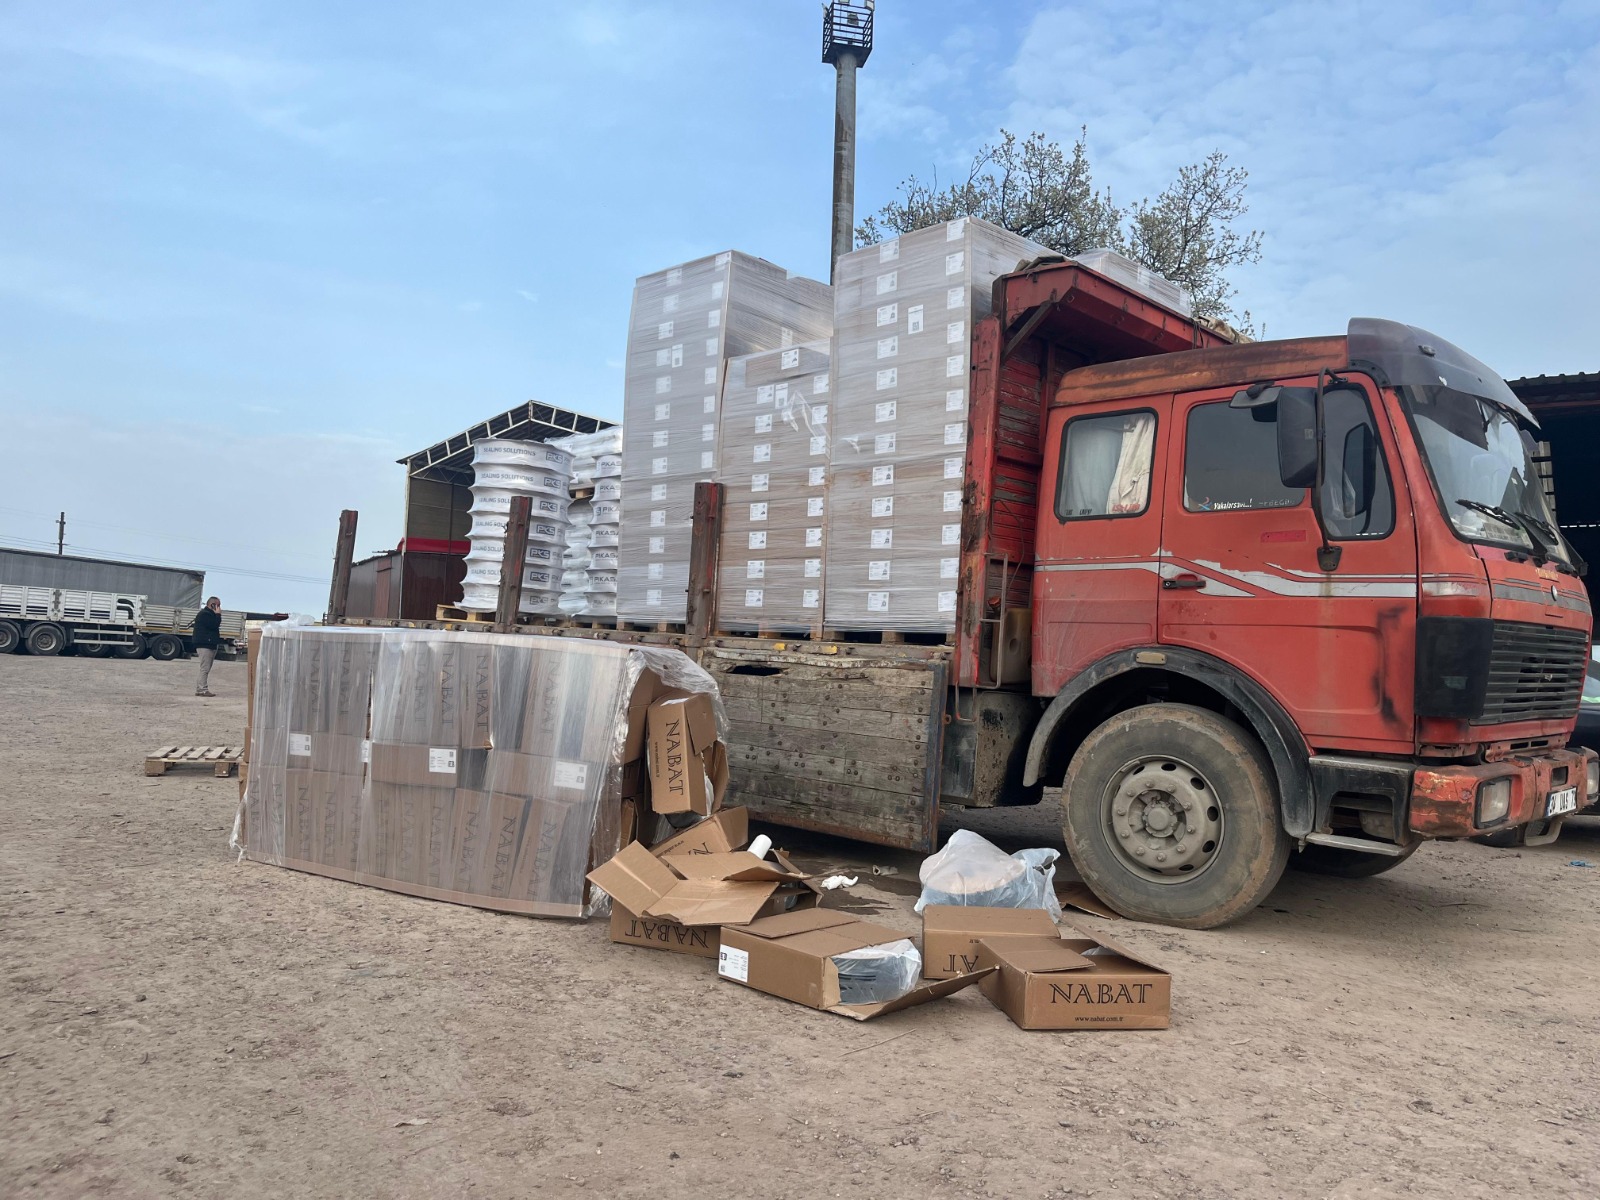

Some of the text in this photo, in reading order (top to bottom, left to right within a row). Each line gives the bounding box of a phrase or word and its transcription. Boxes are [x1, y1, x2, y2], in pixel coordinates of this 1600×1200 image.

[503, 447, 536, 456] SOLUTIONS
[501, 473, 534, 482] SOLUTIONS
[545, 477, 561, 488] PKS
[541, 501, 558, 512] PKS
[537, 525, 555, 536] PKS
[530, 548, 550, 559] PKS
[530, 572, 549, 582] PKS
[442, 650, 454, 729] NABAT
[476, 655, 489, 733] NABAT
[665, 718, 684, 796] NABAT
[458, 809, 479, 891] NABAT
[491, 816, 517, 892] NABAT
[527, 821, 557, 897] NABAT
[625, 919, 709, 949] NABAT
[1048, 983, 1152, 1004] NABAT
